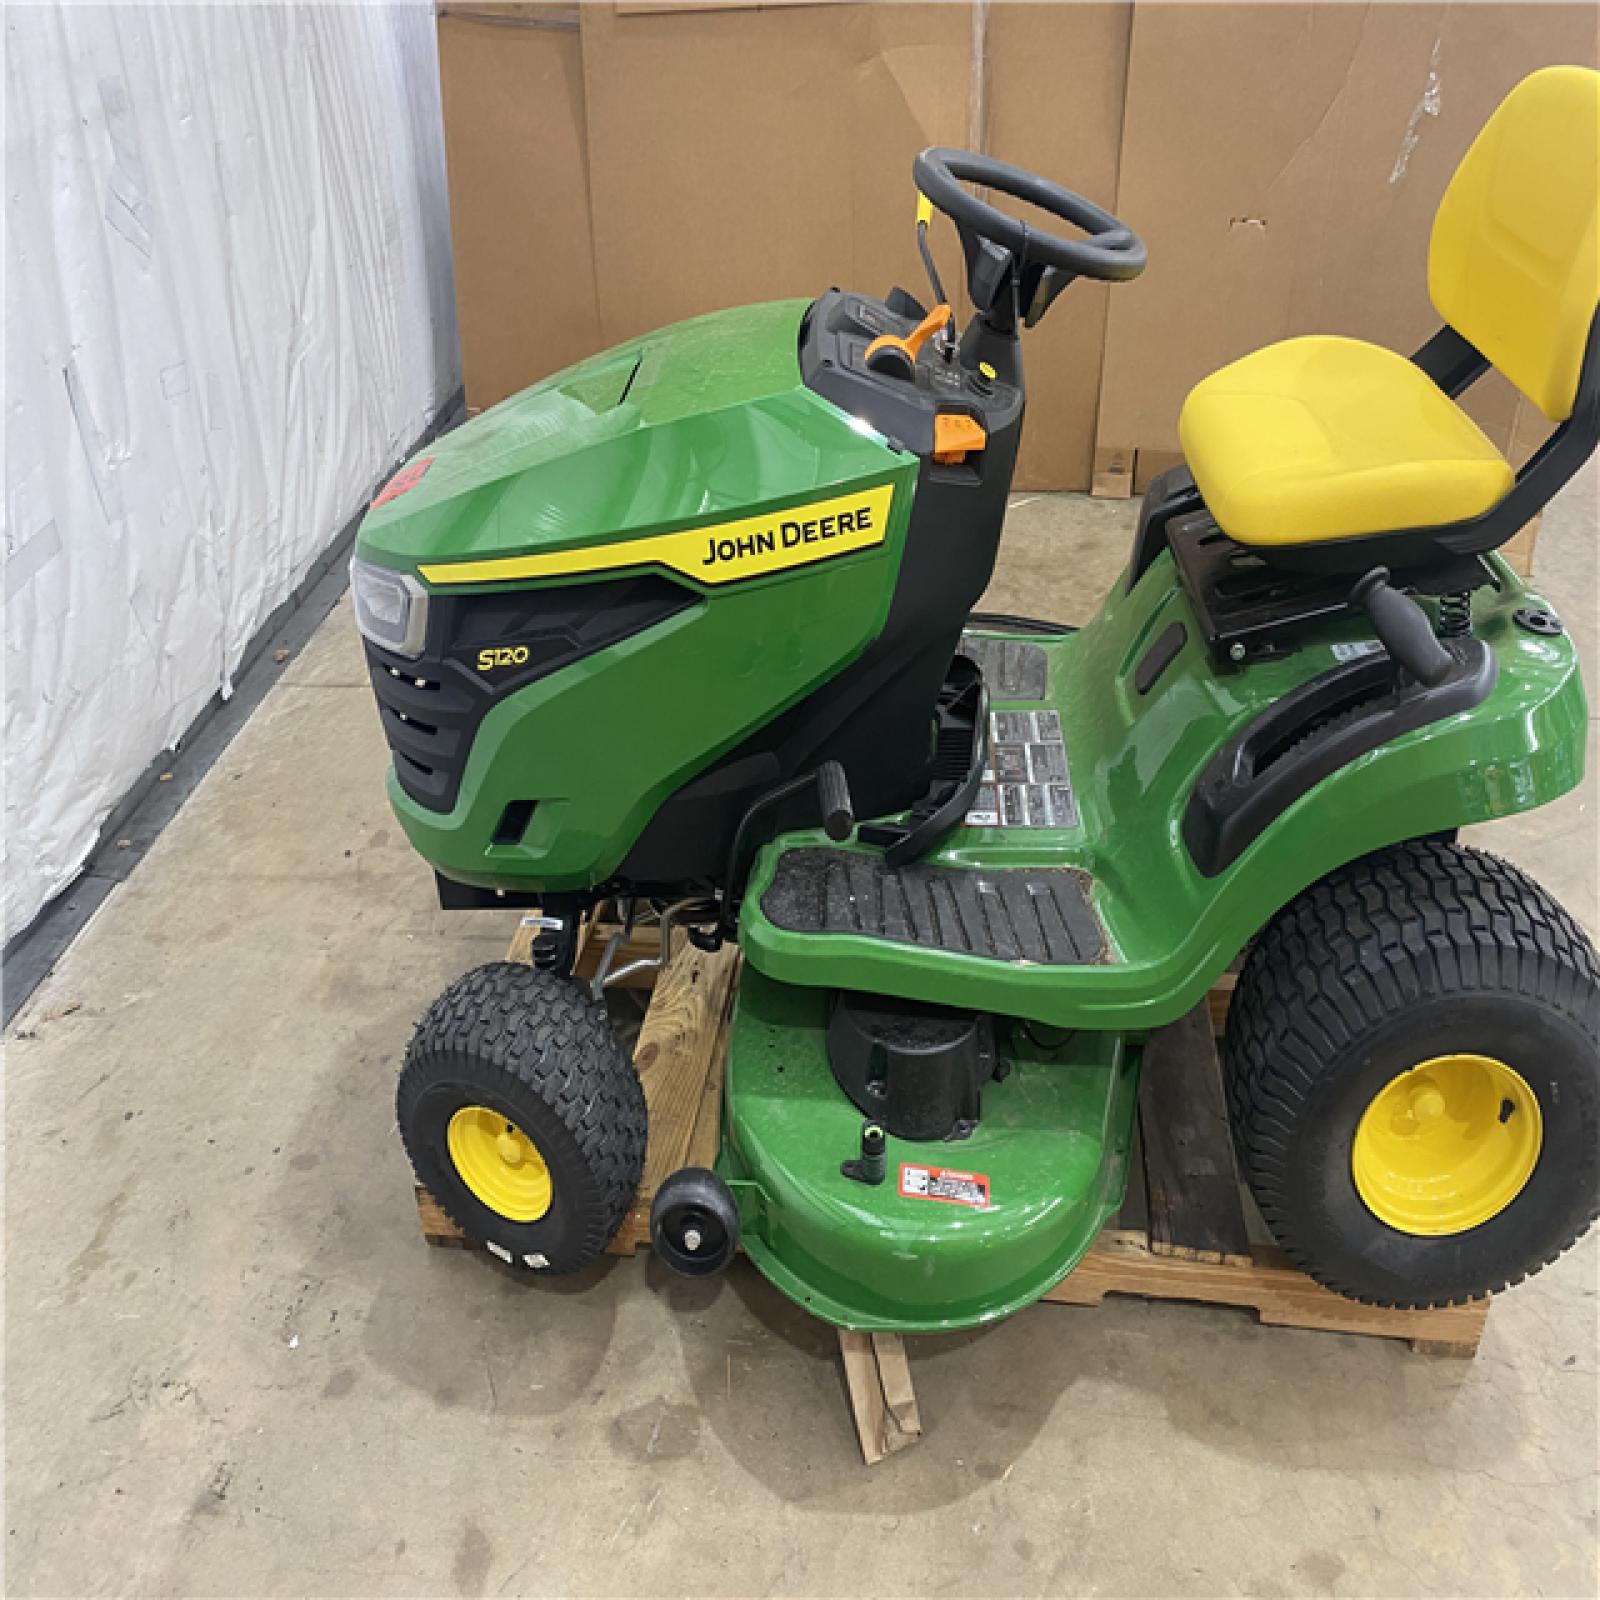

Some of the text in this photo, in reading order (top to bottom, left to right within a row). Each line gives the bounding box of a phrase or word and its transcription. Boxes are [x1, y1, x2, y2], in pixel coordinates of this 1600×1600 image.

[702, 507, 873, 566] JOHN DEERE
[477, 645, 530, 671] S120
